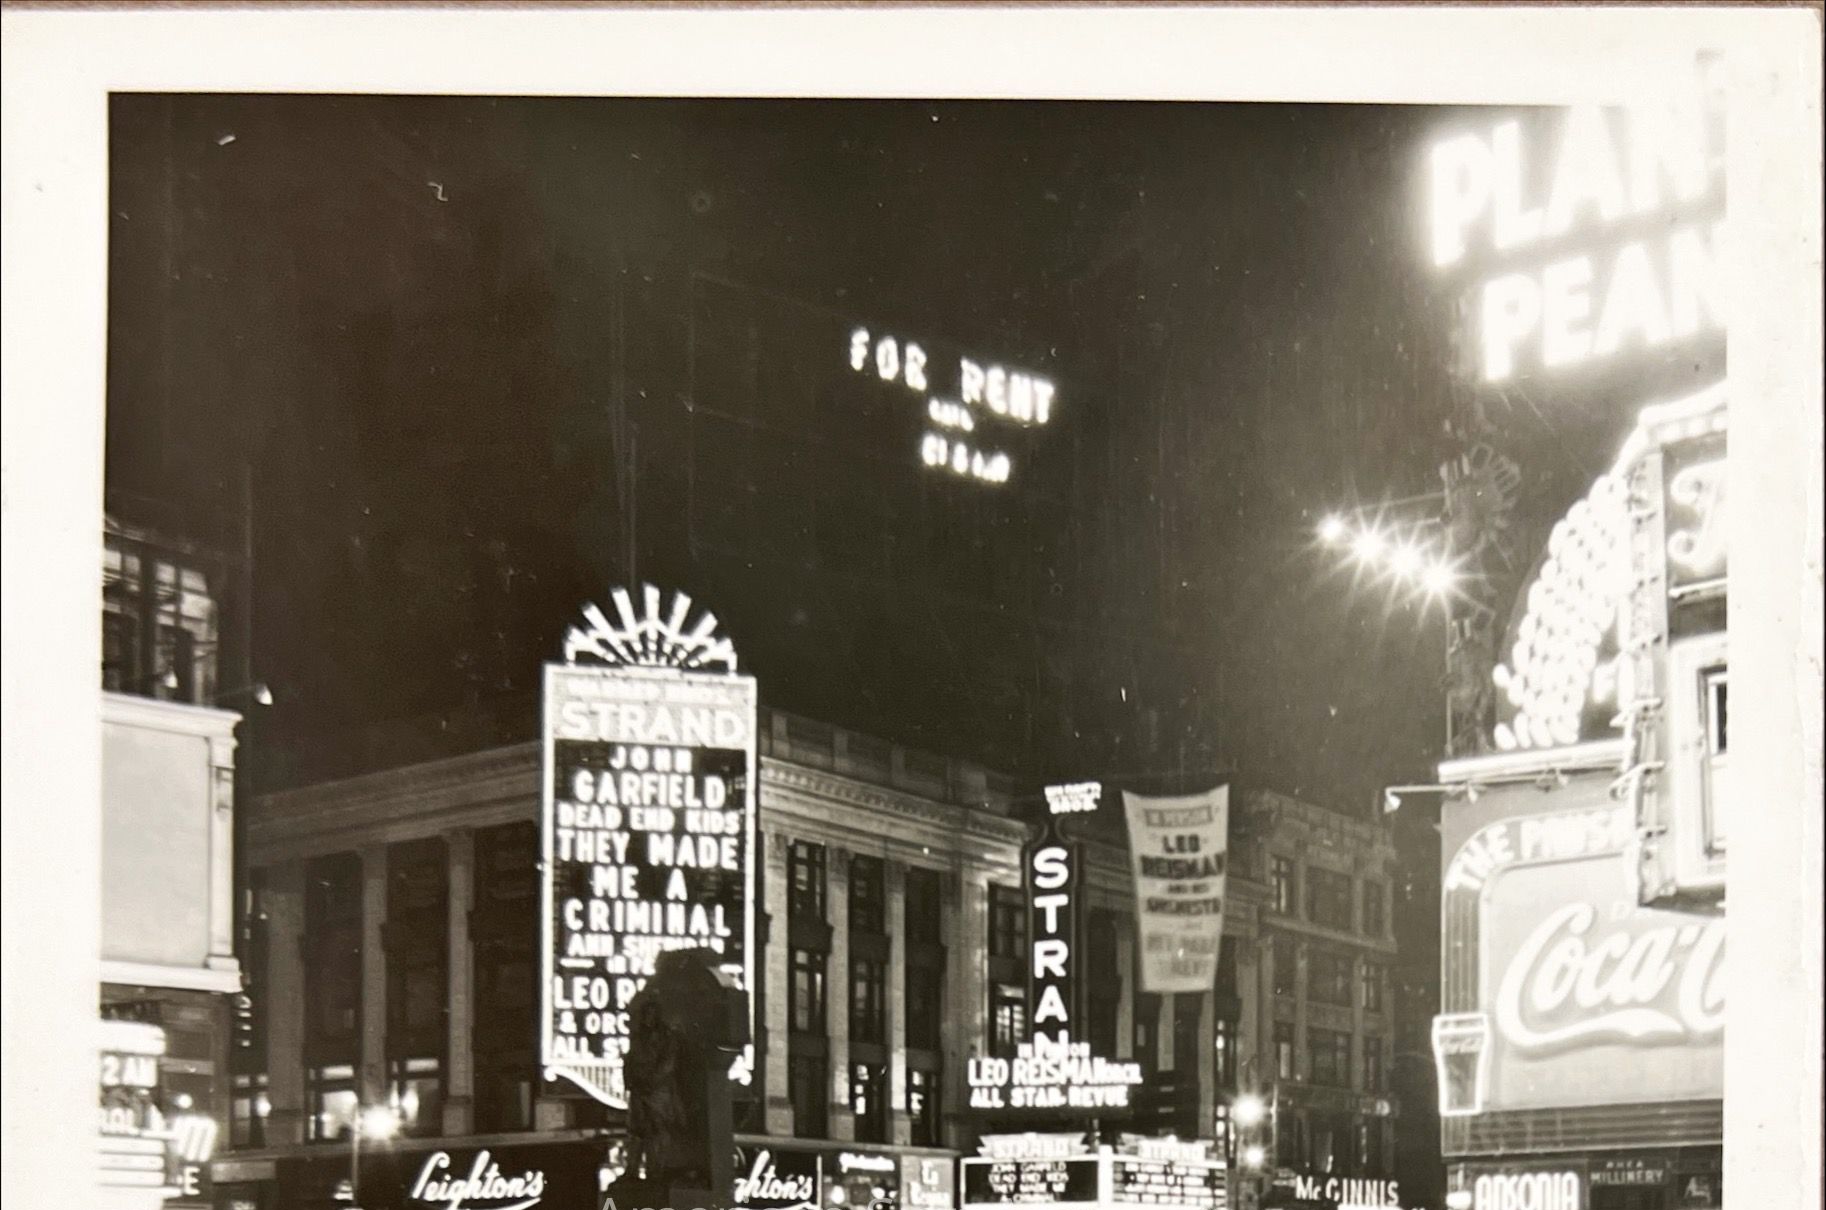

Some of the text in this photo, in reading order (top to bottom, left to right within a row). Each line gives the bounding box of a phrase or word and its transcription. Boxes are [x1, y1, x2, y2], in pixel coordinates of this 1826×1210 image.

[850, 325, 928, 392] FOR
[561, 702, 746, 746] STRAND
[609, 746, 693, 774] JOHN
[573, 769, 726, 809] GARFIELD
[557, 803, 740, 833] DEAD END KIDS
[557, 829, 738, 870] THEY MADE
[1443, 823, 1514, 890] THE
[593, 866, 688, 901] ME A
[564, 898, 731, 937] CRIMINAL
[567, 934, 614, 957] ANN
[553, 974, 610, 1010] LEO
[559, 1010, 577, 1034] &
[553, 1036, 594, 1059] ALL
[968, 1057, 1009, 1087] LEO
[1012, 1056, 1106, 1086] REISMAN
[970, 1084, 1129, 1108] ALL STAR REVUE
[1590, 1169, 1663, 1184] MILLINERY
